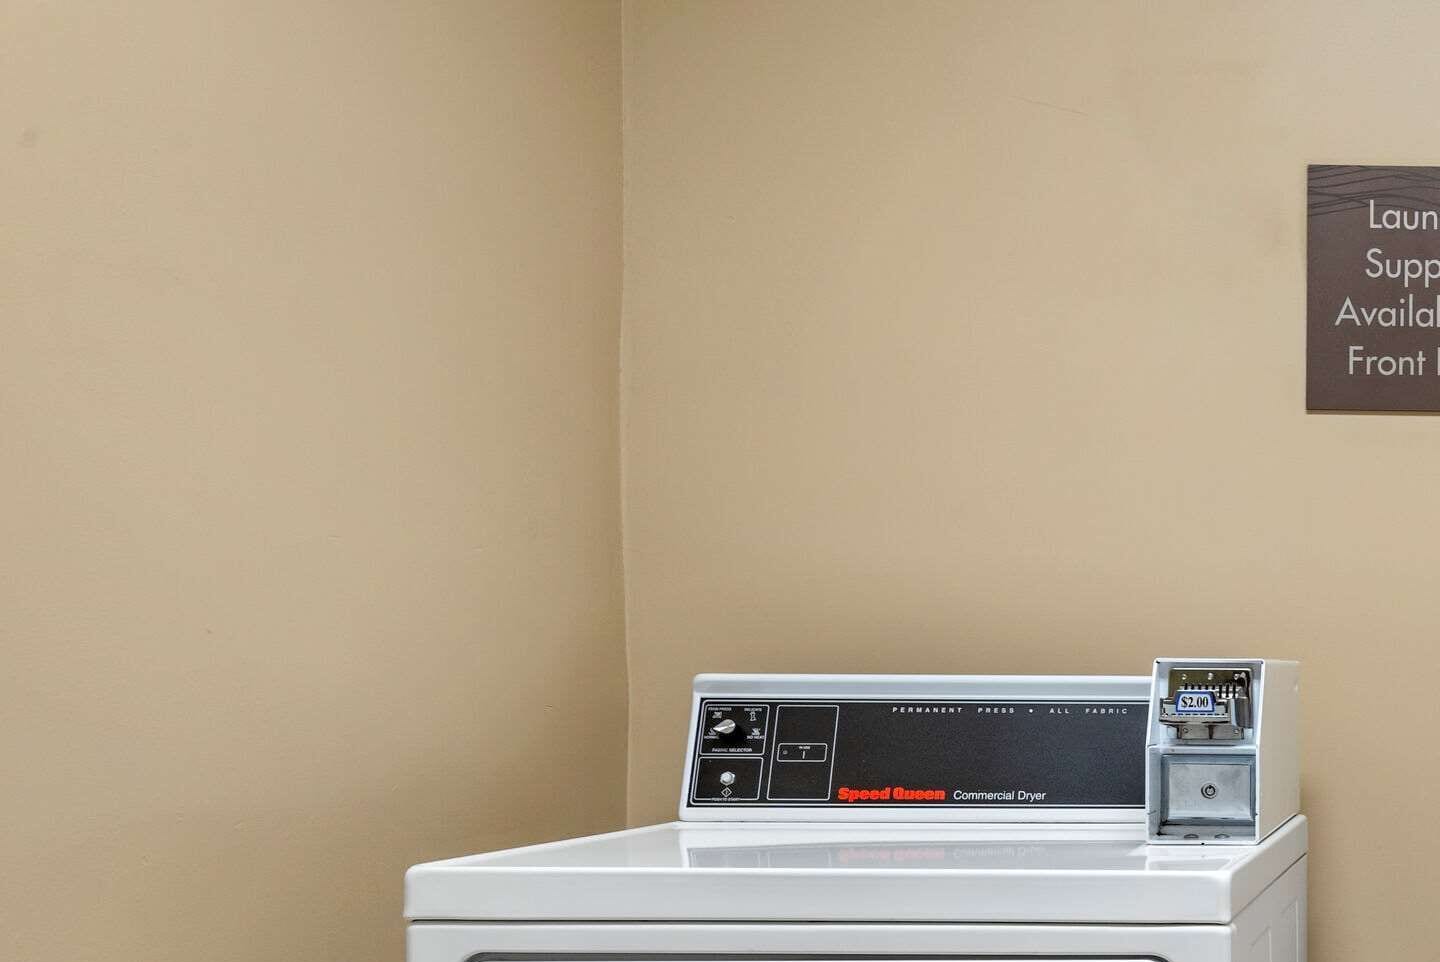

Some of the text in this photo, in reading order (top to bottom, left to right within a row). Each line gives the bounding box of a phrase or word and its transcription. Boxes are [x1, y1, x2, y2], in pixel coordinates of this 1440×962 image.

[1348, 345, 1427, 376] Front
[1181, 696, 1209, 708] $2.00
[892, 706, 963, 714] PERMANENT
[838, 787, 1047, 803] Speed Queen Commercial Dryer
